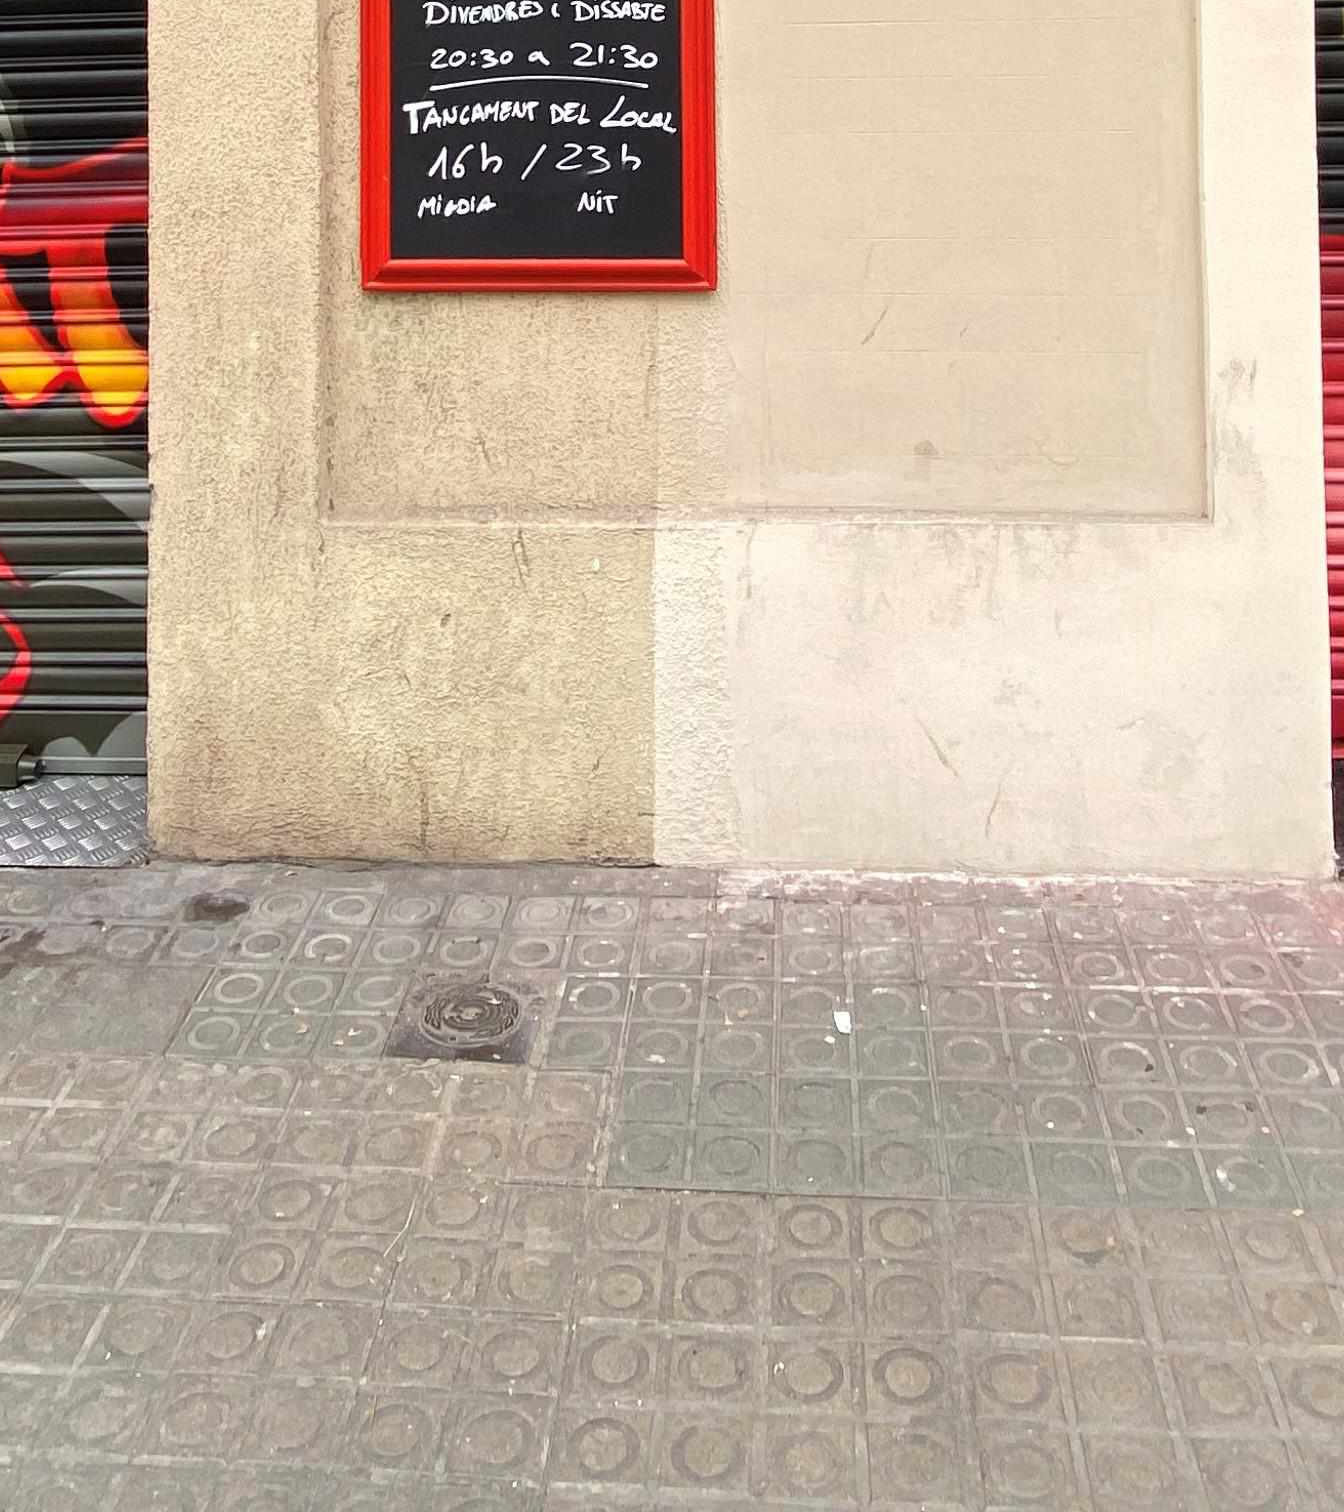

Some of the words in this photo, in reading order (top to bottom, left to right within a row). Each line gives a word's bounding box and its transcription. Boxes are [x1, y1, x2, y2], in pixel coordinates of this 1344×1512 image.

[430, 48, 514, 70] 20:30
[528, 50, 551, 66] a
[569, 42, 658, 69] 21:30
[403, 100, 539, 135] TANCAMENT
[550, 102, 591, 124] DEL
[599, 96, 677, 134] LOCAL
